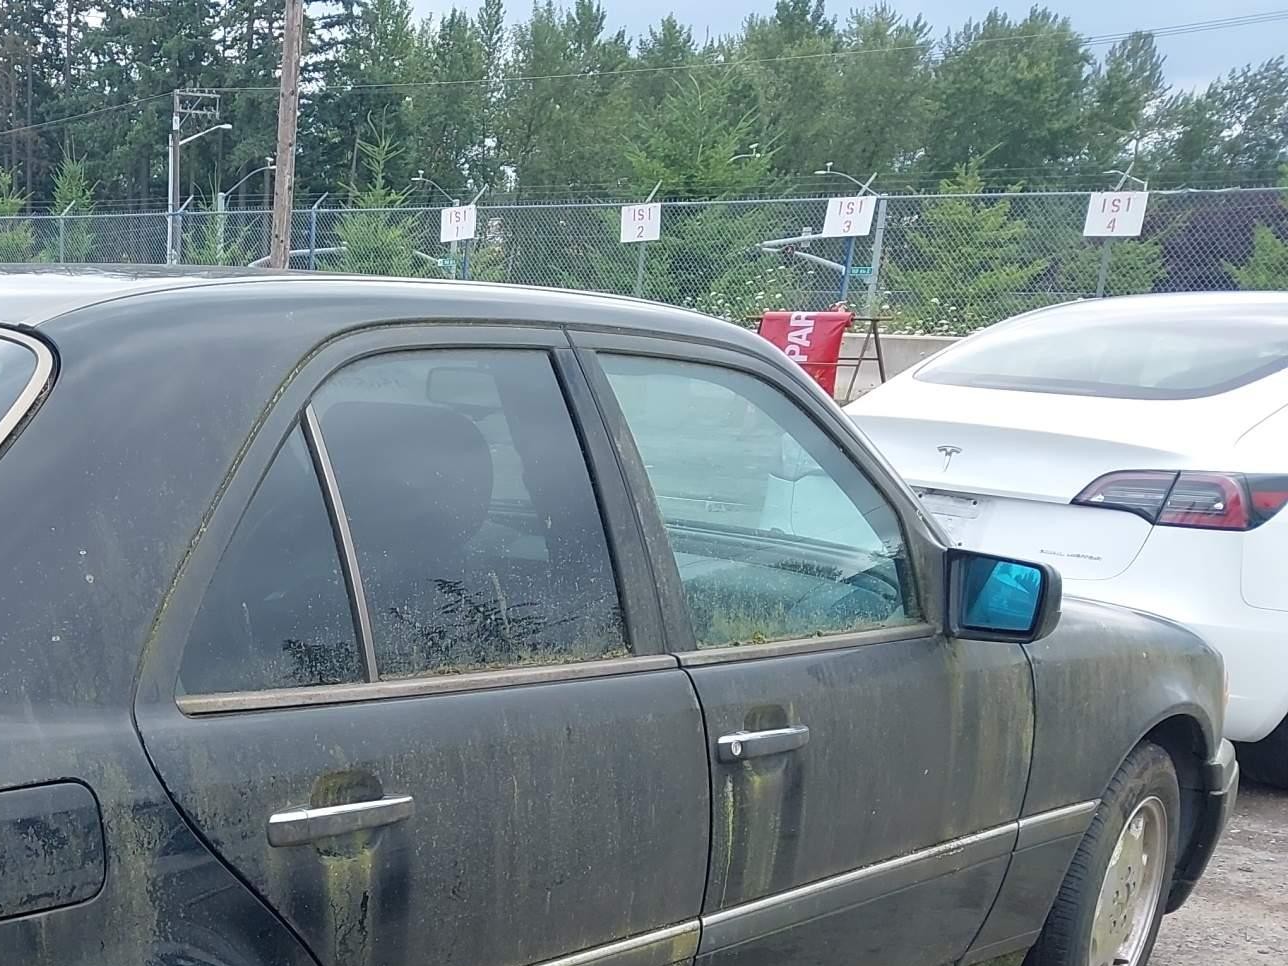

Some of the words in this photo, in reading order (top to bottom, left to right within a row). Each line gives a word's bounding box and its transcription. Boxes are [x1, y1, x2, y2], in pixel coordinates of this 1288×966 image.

[636, 225, 645, 238] 2
[842, 220, 853, 233] 3
[1106, 217, 1117, 233] 4
